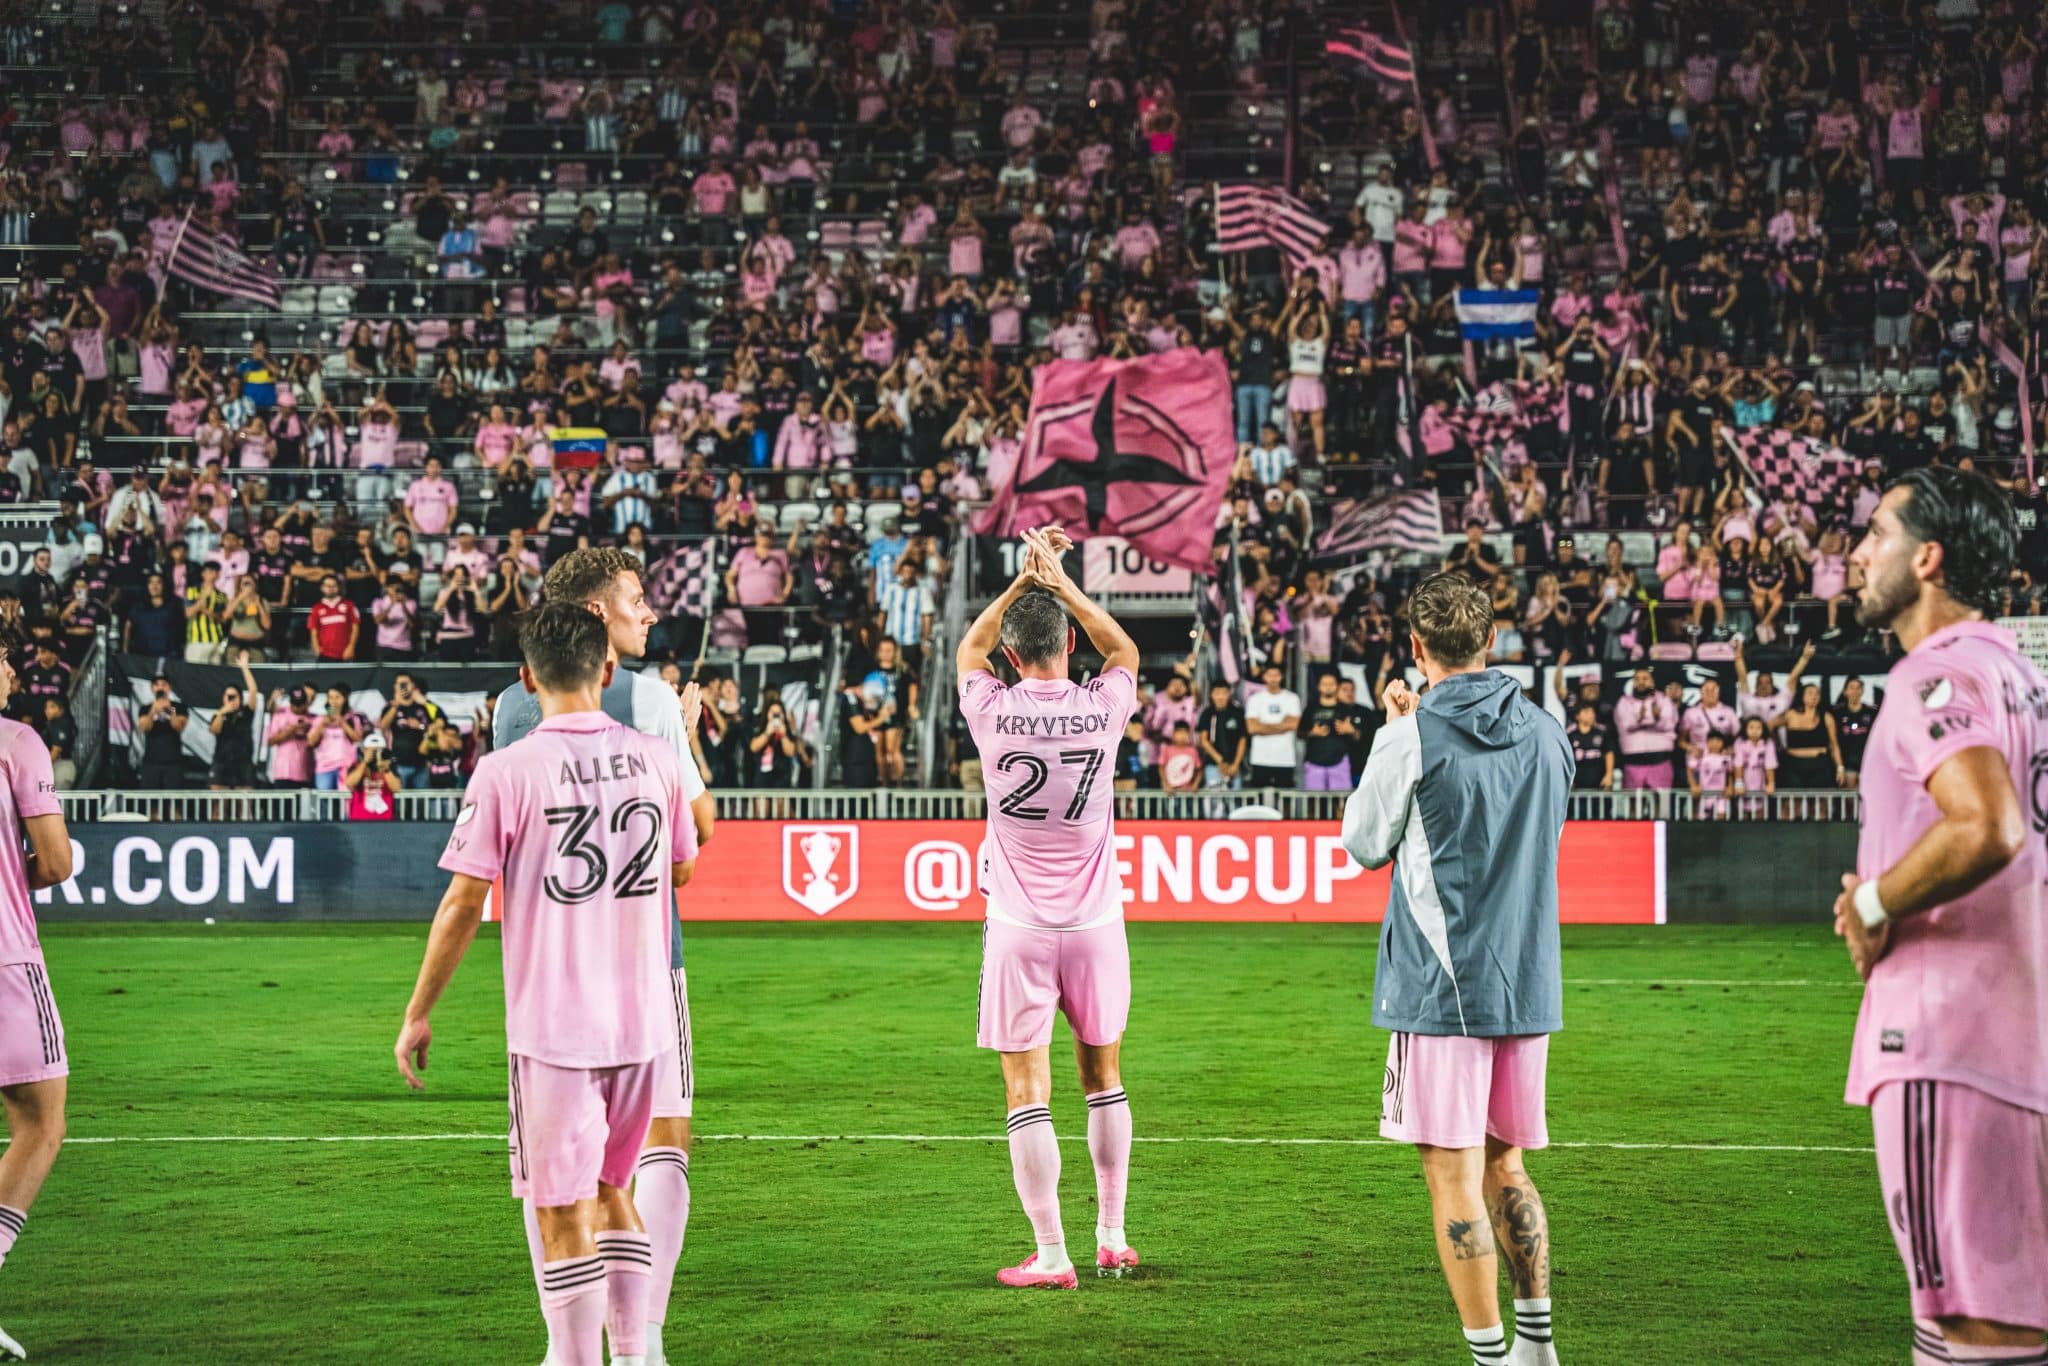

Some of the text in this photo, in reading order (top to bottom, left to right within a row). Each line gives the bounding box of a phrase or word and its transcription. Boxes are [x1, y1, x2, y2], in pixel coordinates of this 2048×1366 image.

[996, 712, 1109, 737] KRYVTSOV
[559, 751, 648, 785] ALLEN
[997, 748, 1105, 820] 27
[544, 797, 662, 905] 32
